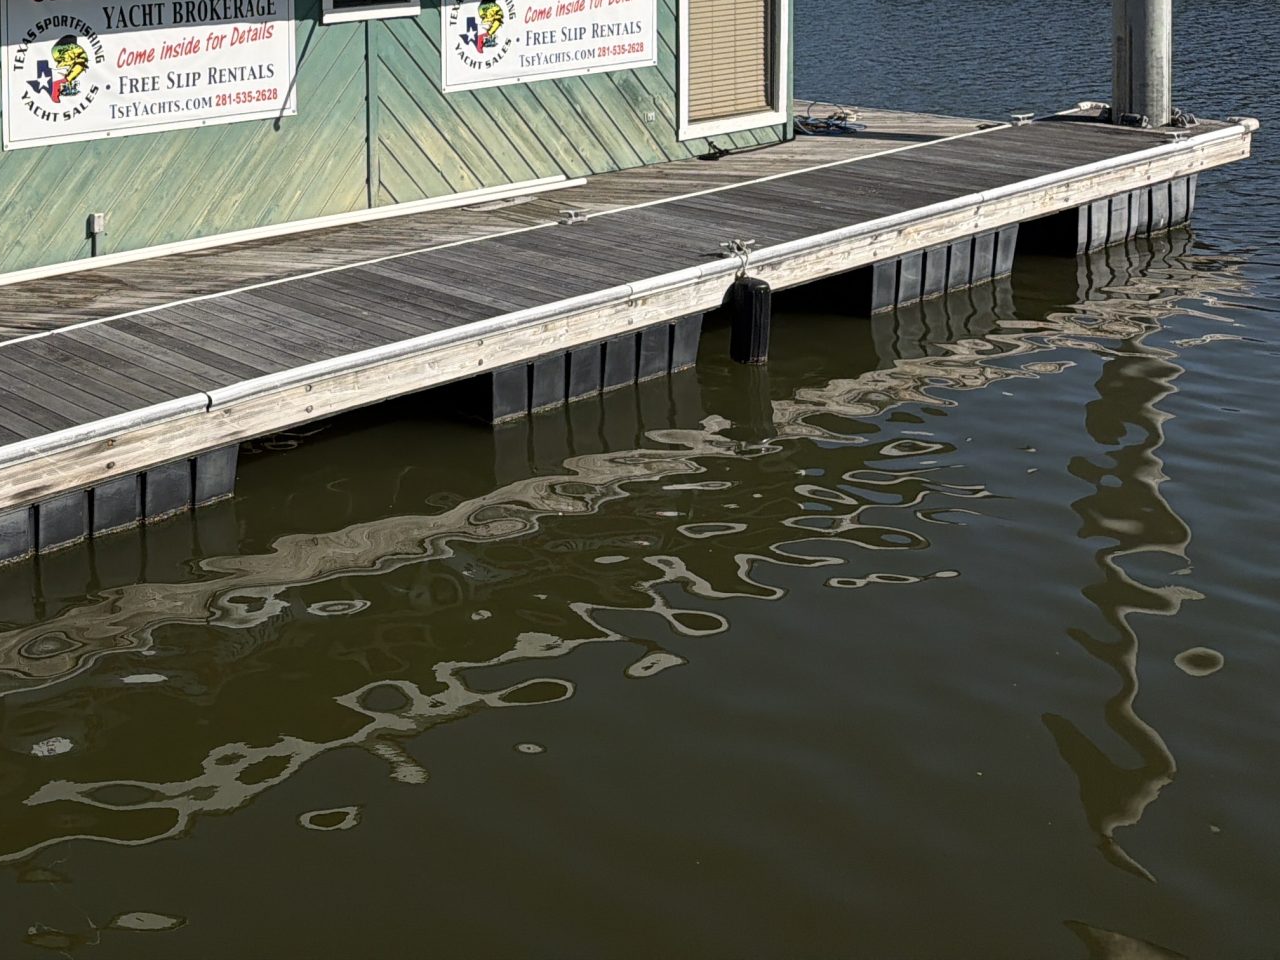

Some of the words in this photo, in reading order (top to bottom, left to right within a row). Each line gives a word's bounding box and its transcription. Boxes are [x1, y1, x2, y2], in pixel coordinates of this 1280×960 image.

[103, 3, 165, 29] YACHT
[524, 6, 552, 24] Come
[556, 0, 585, 17] inside
[14, 29, 37, 72] TEXAS
[35, 15, 105, 64] SPORTFISHING
[117, 47, 154, 68] Come
[160, 39, 200, 60] inside
[206, 31, 227, 49] for
[231, 22, 273, 44] Details
[455, 43, 483, 69] YACHT
[485, 38, 511, 69] SALES
[598, 43, 644, 57] 281-535-2628
[21, 90, 60, 122] YACHT
[63, 85, 99, 121] SALES
[215, 88, 278, 107] 281-535-2628
